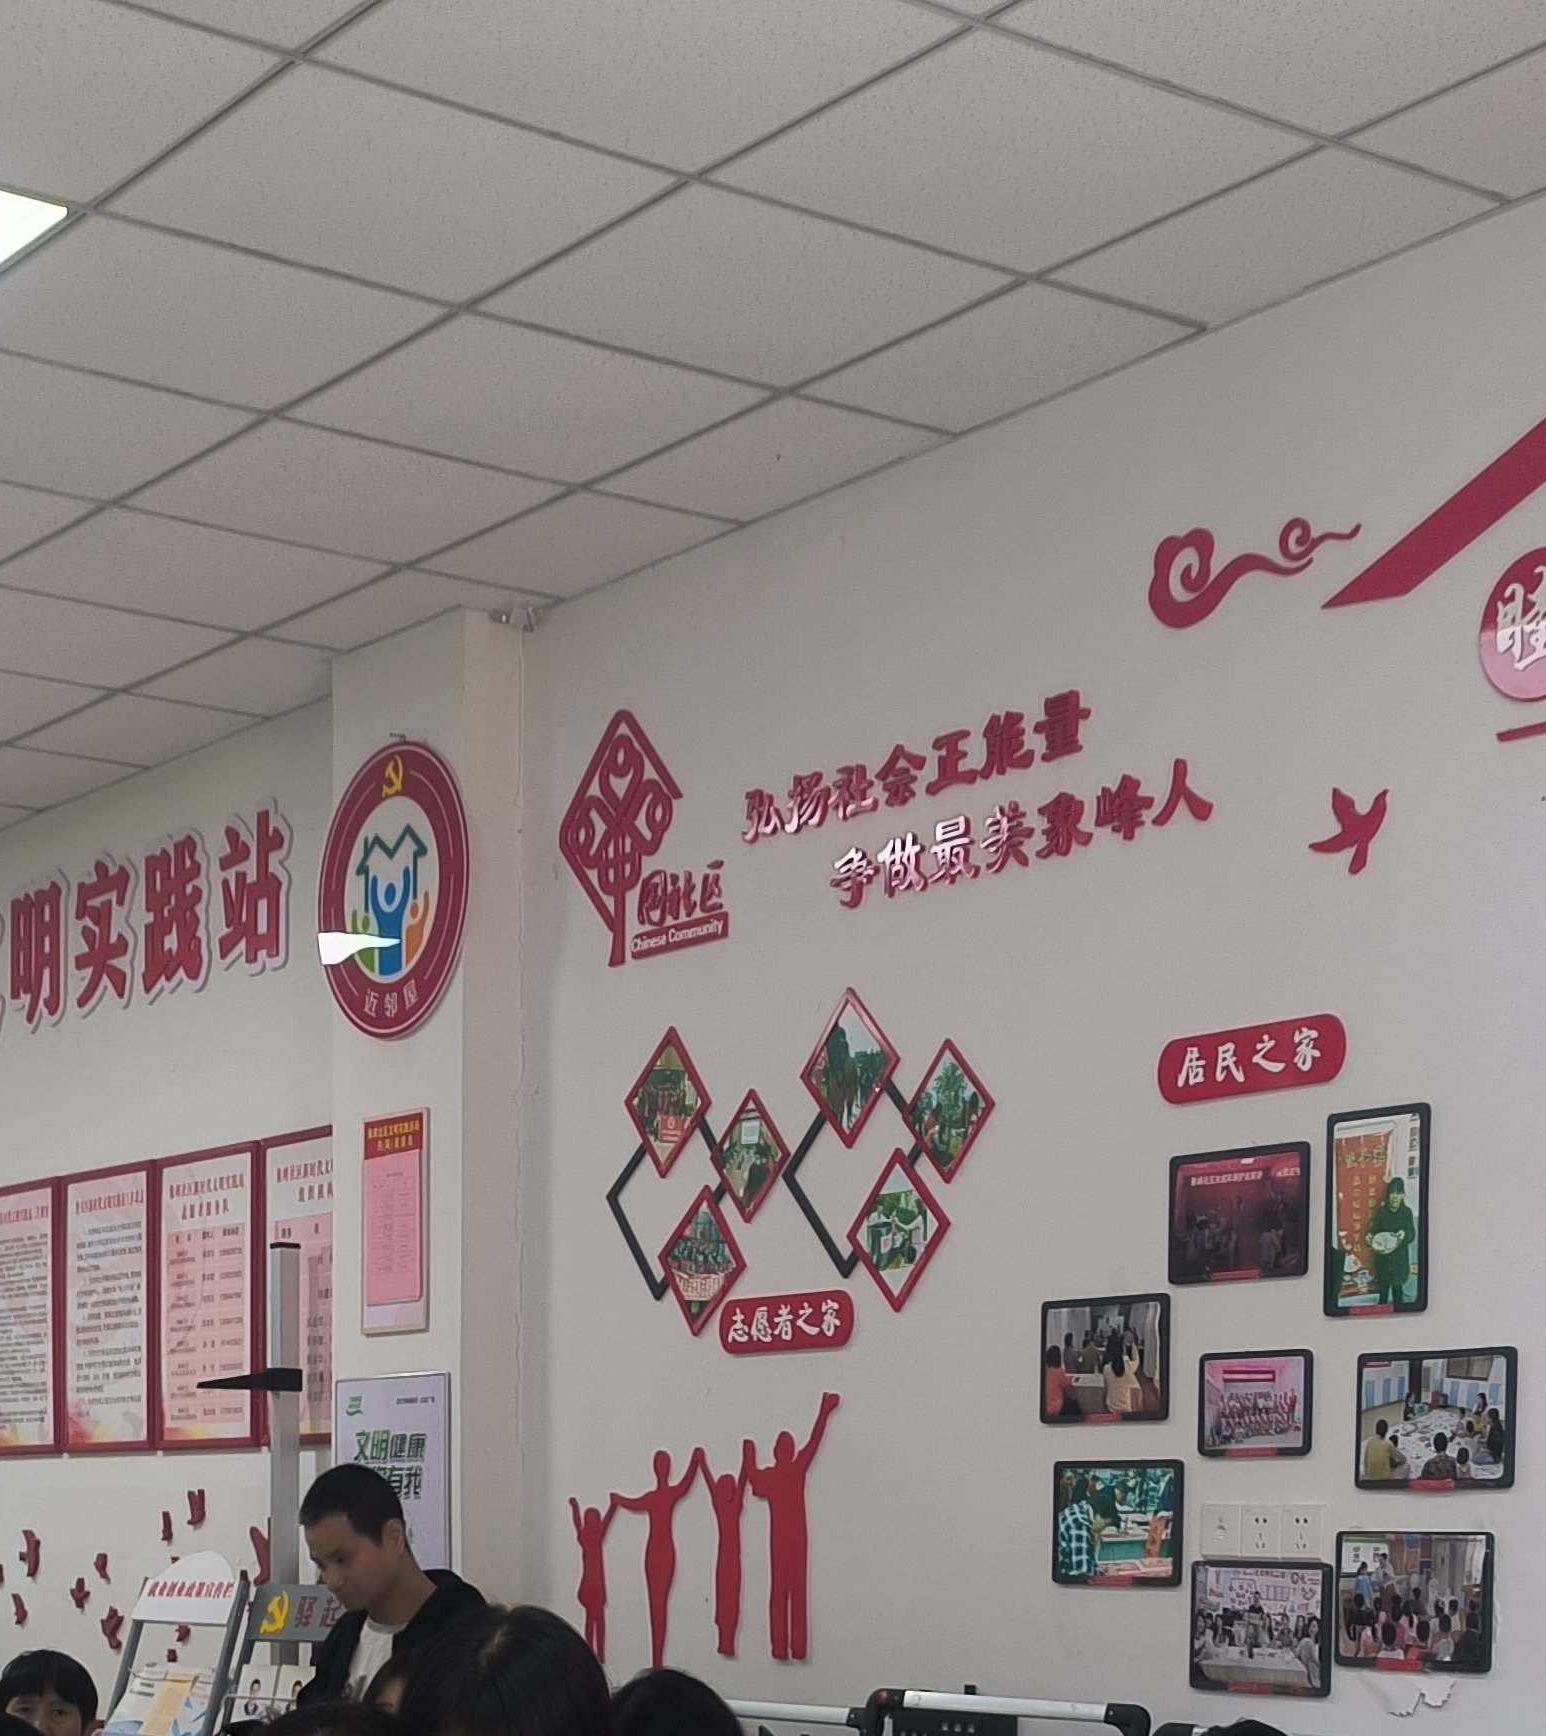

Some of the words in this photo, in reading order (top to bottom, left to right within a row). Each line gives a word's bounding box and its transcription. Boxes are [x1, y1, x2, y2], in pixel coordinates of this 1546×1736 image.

[743, 690, 1091, 842] 弘扬社会正能量
[831, 758, 1213, 908] 争做最美象峰人
[632, 935, 667, 953] Chinese
[668, 919, 724, 944] Community
[1178, 1027, 1321, 1087] 居民之家
[726, 1299, 842, 1344] 志愿者之家
[354, 1429, 427, 1463] 文明健康
